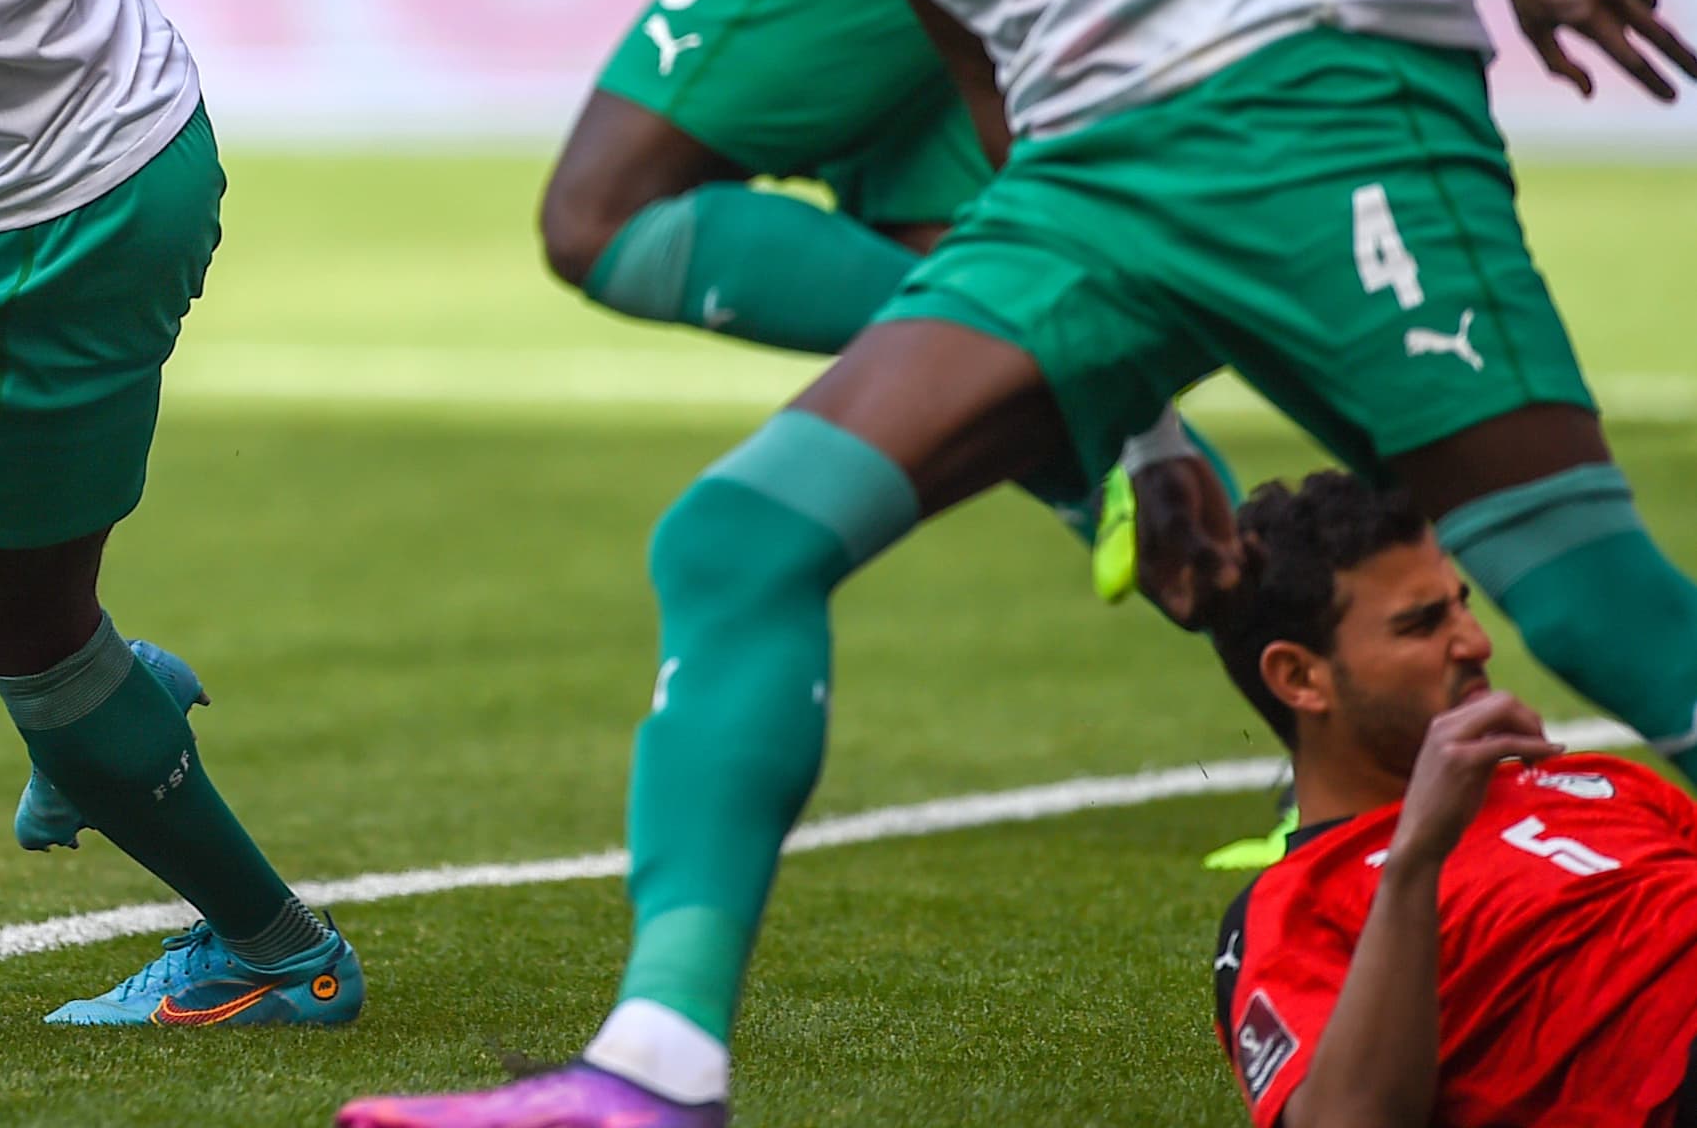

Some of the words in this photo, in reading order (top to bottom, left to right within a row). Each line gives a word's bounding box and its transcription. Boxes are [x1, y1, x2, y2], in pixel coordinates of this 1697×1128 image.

[1351, 182, 1426, 310] 4
[152, 749, 190, 801] FSF
[1500, 814, 1624, 877] 5
